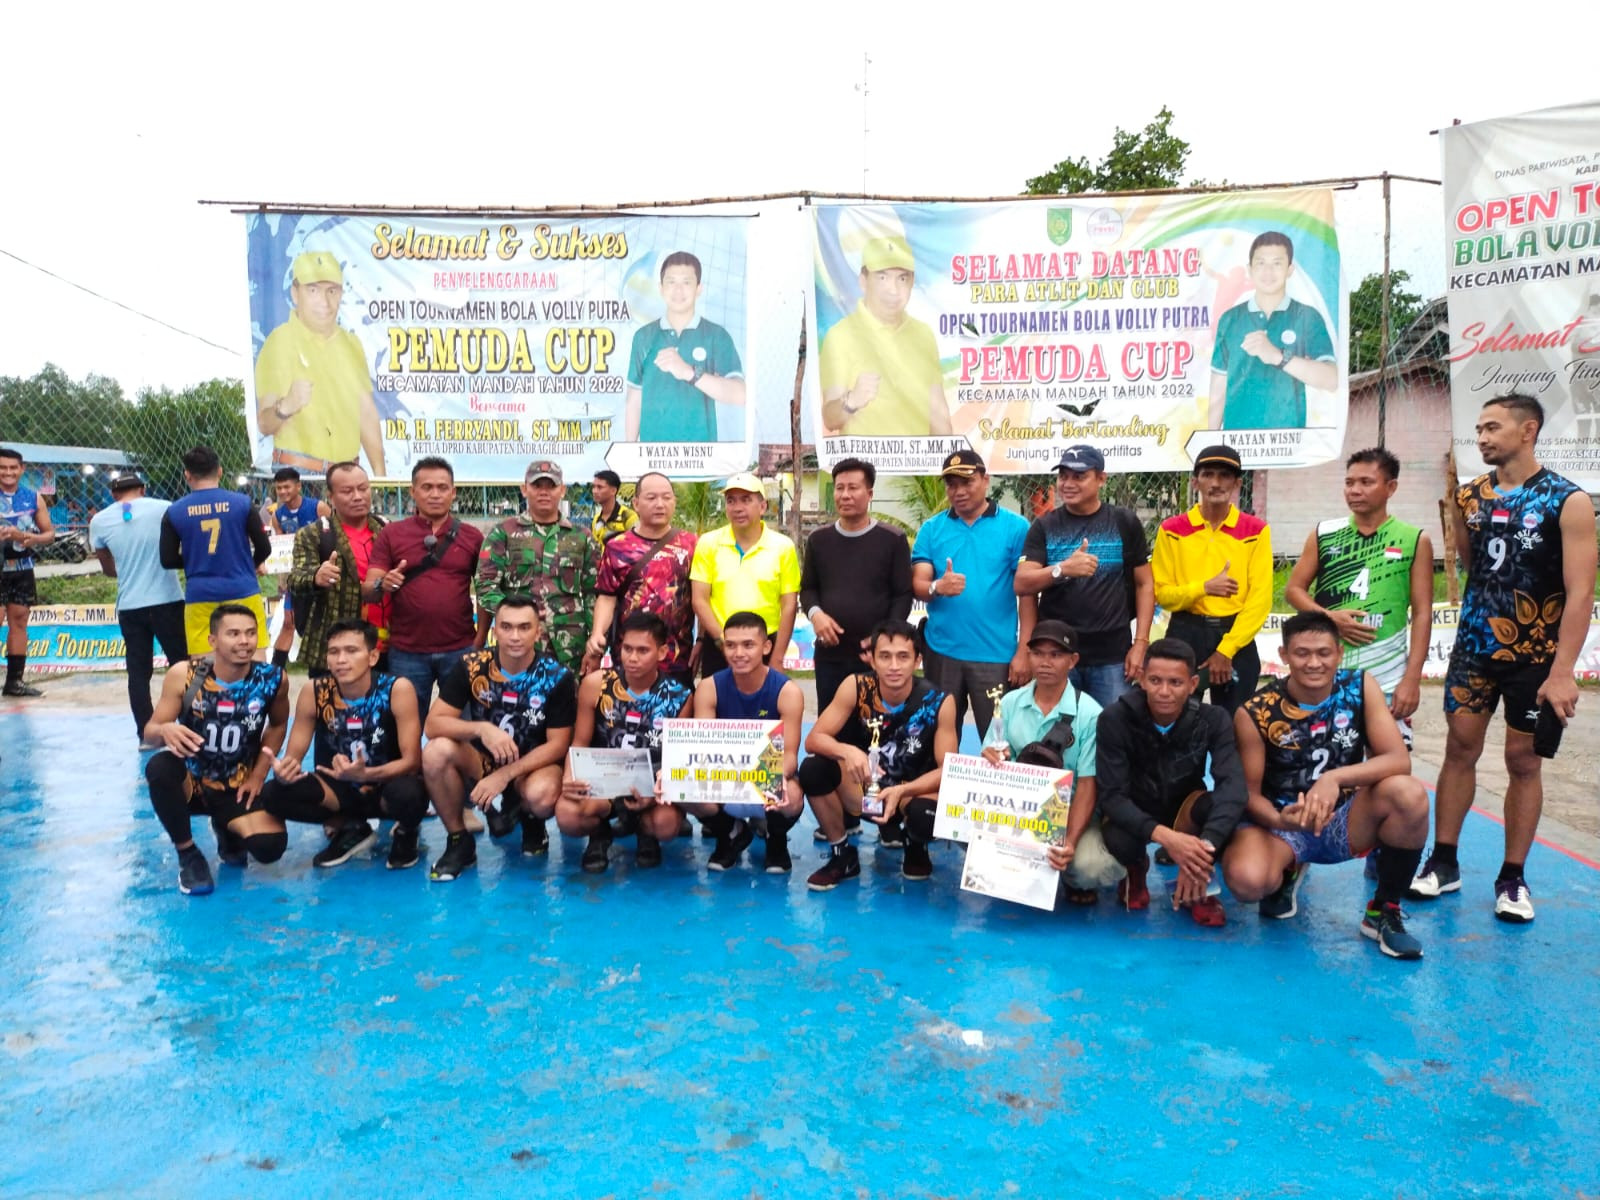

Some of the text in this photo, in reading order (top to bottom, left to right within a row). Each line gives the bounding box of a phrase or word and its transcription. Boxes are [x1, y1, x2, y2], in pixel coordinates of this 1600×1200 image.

[1495, 166, 1526, 179] DINAS
[1456, 190, 1558, 233] OPEN
[371, 223, 628, 261] Selamat & Sukses
[1455, 230, 1538, 266] BOLA
[951, 247, 1201, 284] SELAMAT DATANG
[1450, 260, 1570, 290] KECAMATAN
[433, 272, 557, 289] PENYELENGGARAAN
[971, 278, 1179, 303] PARA ATLIT DAN CLUB
[369, 299, 630, 320] OPEN TOURNAMEN BOLA VOLLY PUTRA
[980, 310, 1068, 334] TOURNAMEN
[1073, 308, 1110, 331] BOLA
[1115, 307, 1158, 330] VOLLY
[1162, 306, 1209, 328] PUTRA
[1444, 315, 1584, 363] Selamat
[388, 327, 616, 373] PEMUDA CUP
[958, 340, 1195, 384] PEMUDA CUP
[377, 376, 623, 393] KECAMATAN MANDAH TAHUN 2022
[1471, 364, 1556, 394] Junjung
[469, 393, 526, 413] Bersama
[958, 384, 1194, 401] KECAMATAN MANDAH TAHUN 2022
[386, 419, 411, 440] DR.
[415, 419, 430, 440] H.
[435, 419, 524, 442] FERRYANDI,
[978, 414, 1170, 447] Selamat Bertanding
[1229, 434, 1266, 446] WAYAN
[1269, 432, 1301, 445] WISNU
[413, 442, 585, 455] KETUA DPRD KABUPATEN INDRAGIRI HILIR
[646, 446, 680, 457] WAYAN
[683, 446, 713, 457] WISNU
[850, 440, 907, 456] FERRYANDI,
[1006, 447, 1049, 460] Junjung
[1236, 447, 1293, 458] ETUA PANITIA
[648, 460, 705, 469] KETUA PANITIA
[188, 502, 229, 517] RUDI VC
[201, 518, 221, 555] 7
[1487, 537, 1507, 571] 9
[1350, 568, 1370, 600] 4
[668, 721, 764, 730] OPEN TOURNAMENT
[747, 731, 764, 739] CUP
[204, 723, 240, 753] 10
[686, 753, 751, 766] JUARA II
[950, 756, 976, 766] OPEN
[1312, 749, 1329, 780] 2
[1032, 777, 1050, 787] CUP
[963, 791, 1039, 812] JUARA III
